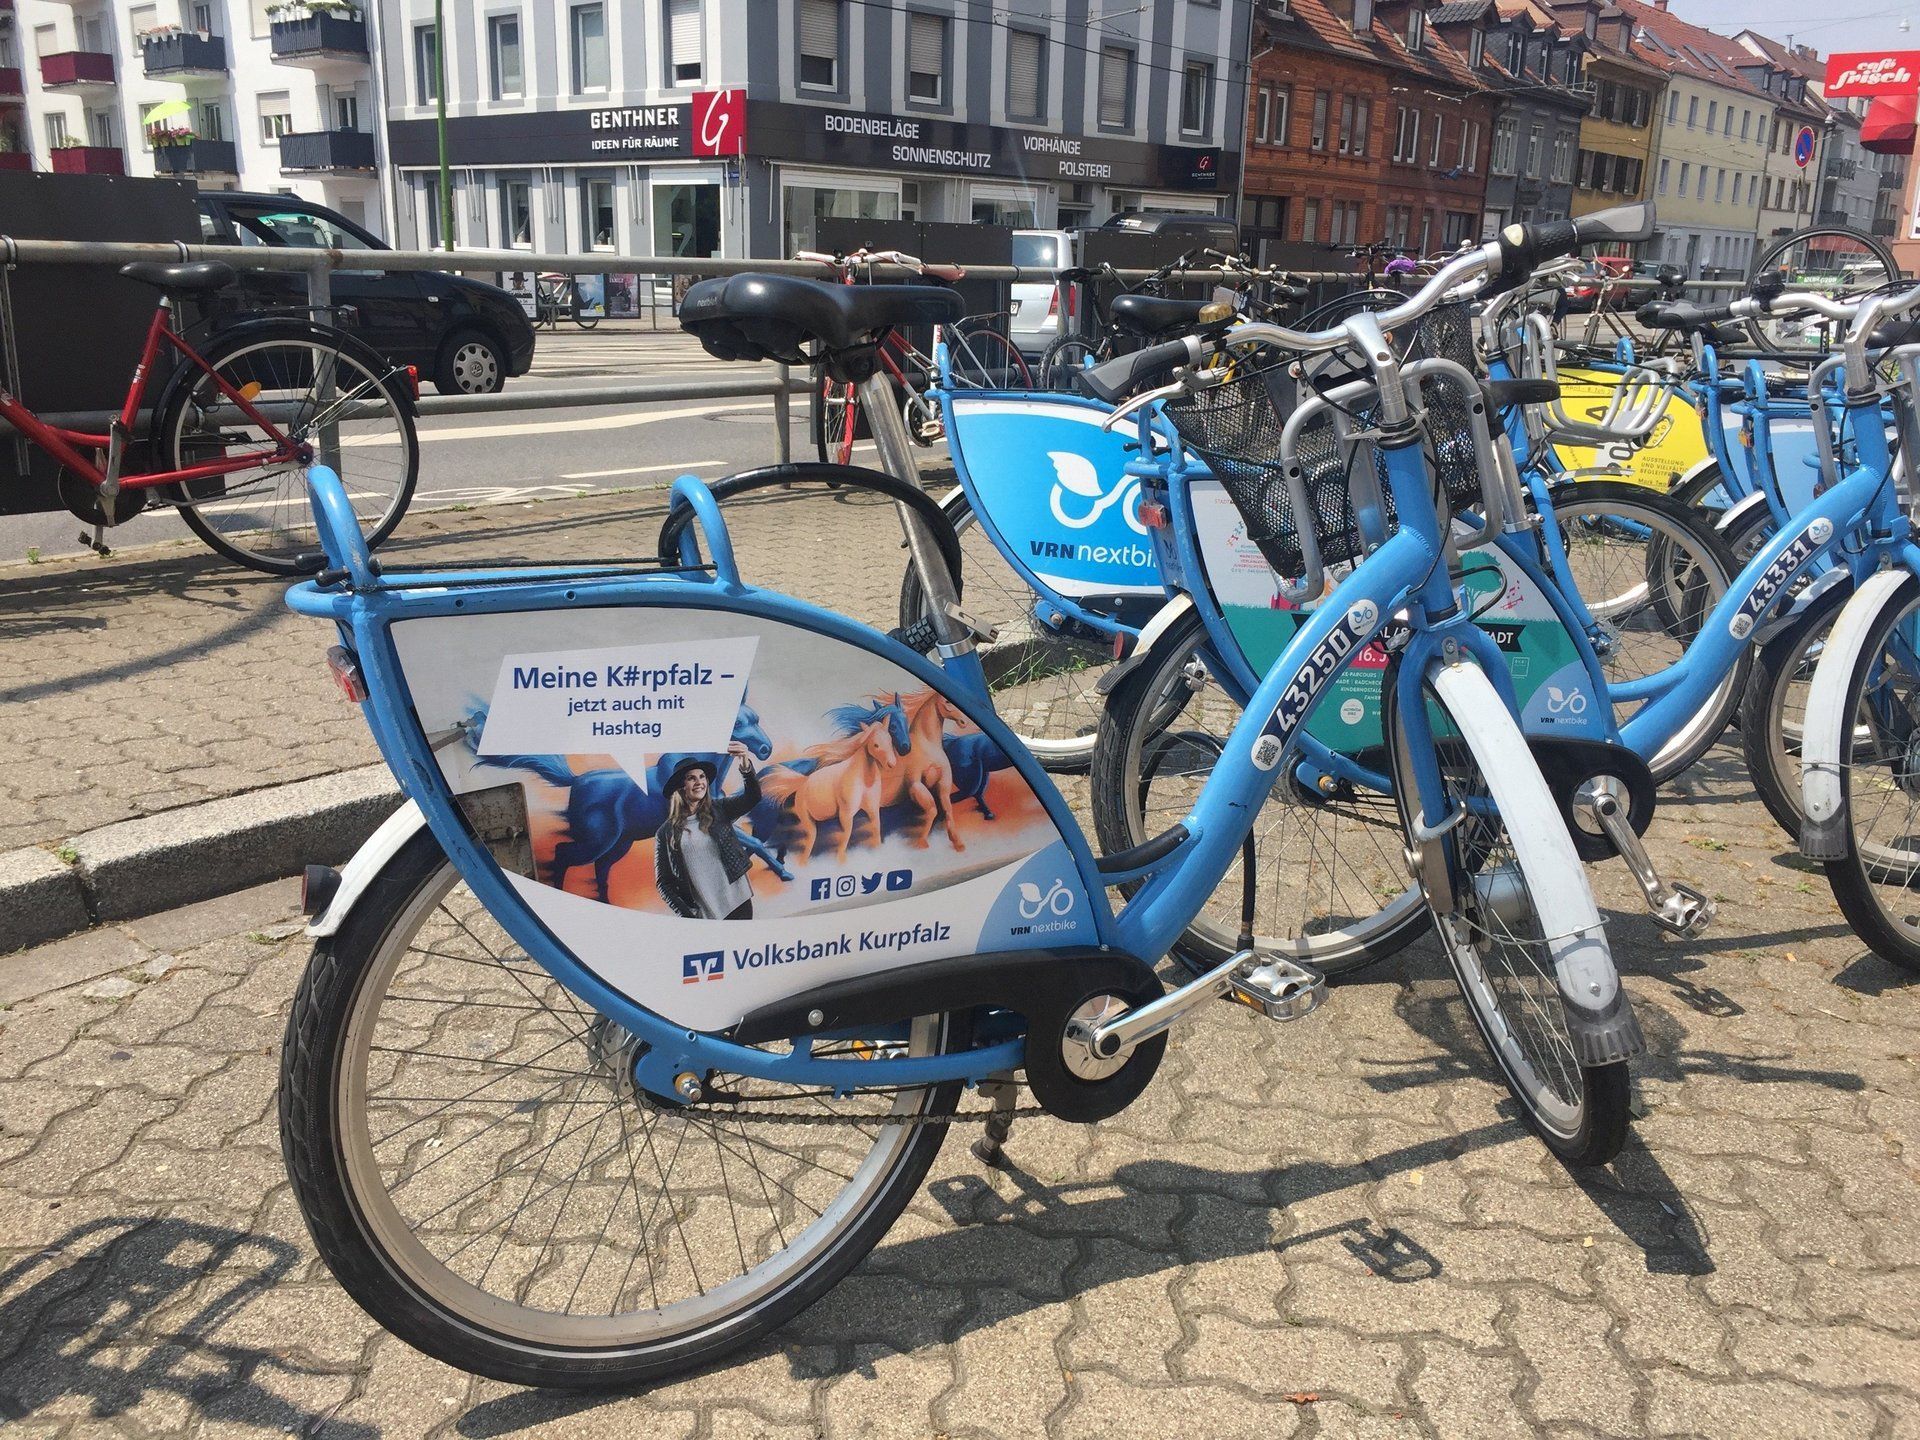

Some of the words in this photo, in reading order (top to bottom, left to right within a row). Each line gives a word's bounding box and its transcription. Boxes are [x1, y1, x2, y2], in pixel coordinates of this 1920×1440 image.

[1828, 67, 1912, 90] frisch
[590, 107, 680, 129] GENTHNER
[825, 114, 920, 140] BODENBELÄGE
[591, 140, 620, 150] IDEEN
[622, 136, 642, 148] FÜR
[644, 136, 679, 148] RÄUME
[1023, 136, 1081, 155] VORHÄNGE
[892, 145, 992, 168] SONNENSCHUTZ
[1058, 160, 1111, 178] POLSTEREI
[1642, 456, 1685, 467] AUSSTELLUNG
[1029, 540, 1075, 560] VRN
[1077, 543, 1157, 568] nextbi
[1749, 539, 1812, 613] 43331
[1485, 631, 1514, 644] ADT
[513, 666, 598, 689] Meine
[606, 663, 713, 692] K#rpfalz
[1275, 628, 1351, 732] 43250
[567, 697, 607, 717] jetzt
[612, 695, 651, 711] auch
[657, 695, 685, 710] mit
[592, 720, 662, 738] Hashtag
[1555, 716, 1588, 726] nextbike
[1010, 926, 1031, 936] VRN
[1031, 920, 1077, 934] nextbike
[732, 933, 852, 970] Volksbank
[858, 921, 951, 951] Kurpfalz
